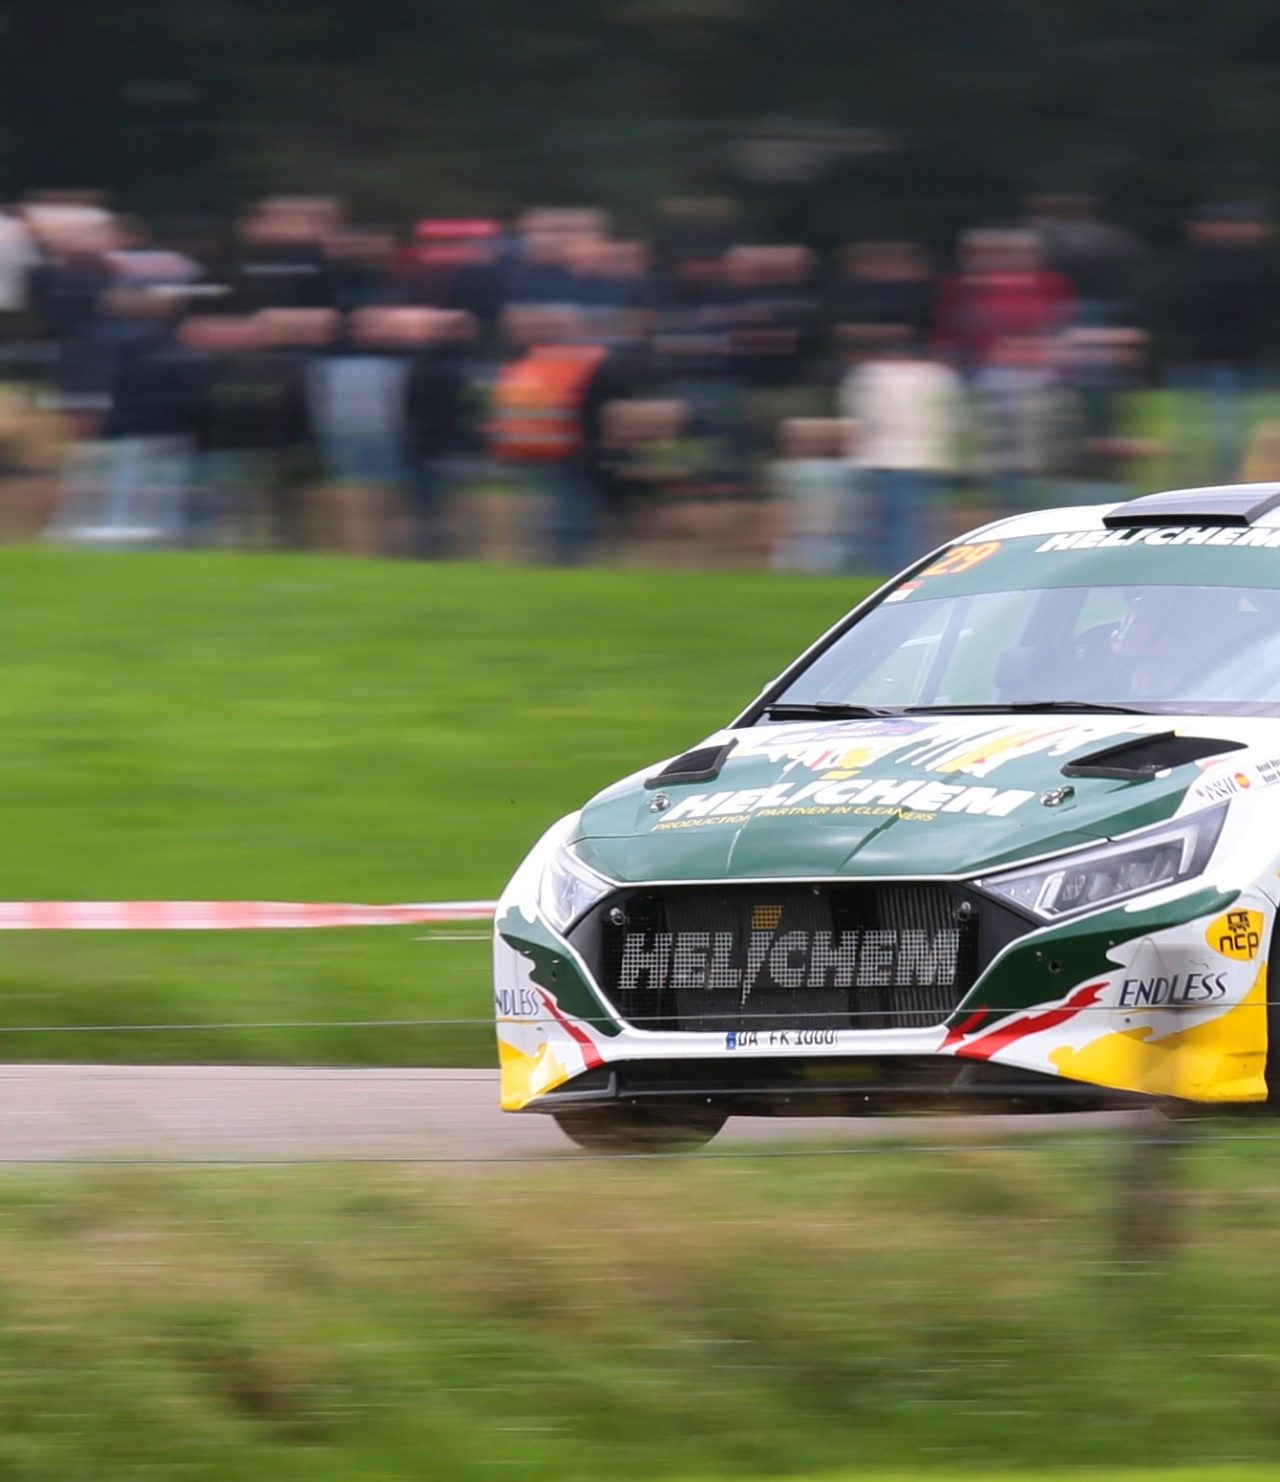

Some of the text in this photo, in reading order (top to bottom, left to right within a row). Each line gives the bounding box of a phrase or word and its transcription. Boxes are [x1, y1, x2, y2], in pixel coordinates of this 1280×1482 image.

[919, 542, 1003, 577] 29
[660, 769, 1036, 818] HELICHEM
[756, 805, 832, 819] PARTNER
[831, 805, 852, 816] IN
[617, 904, 961, 1008] HELICHEM
[1219, 931, 1260, 959] ncp
[495, 988, 540, 1016] NDLESS
[1118, 971, 1228, 1007] ENDLESS
